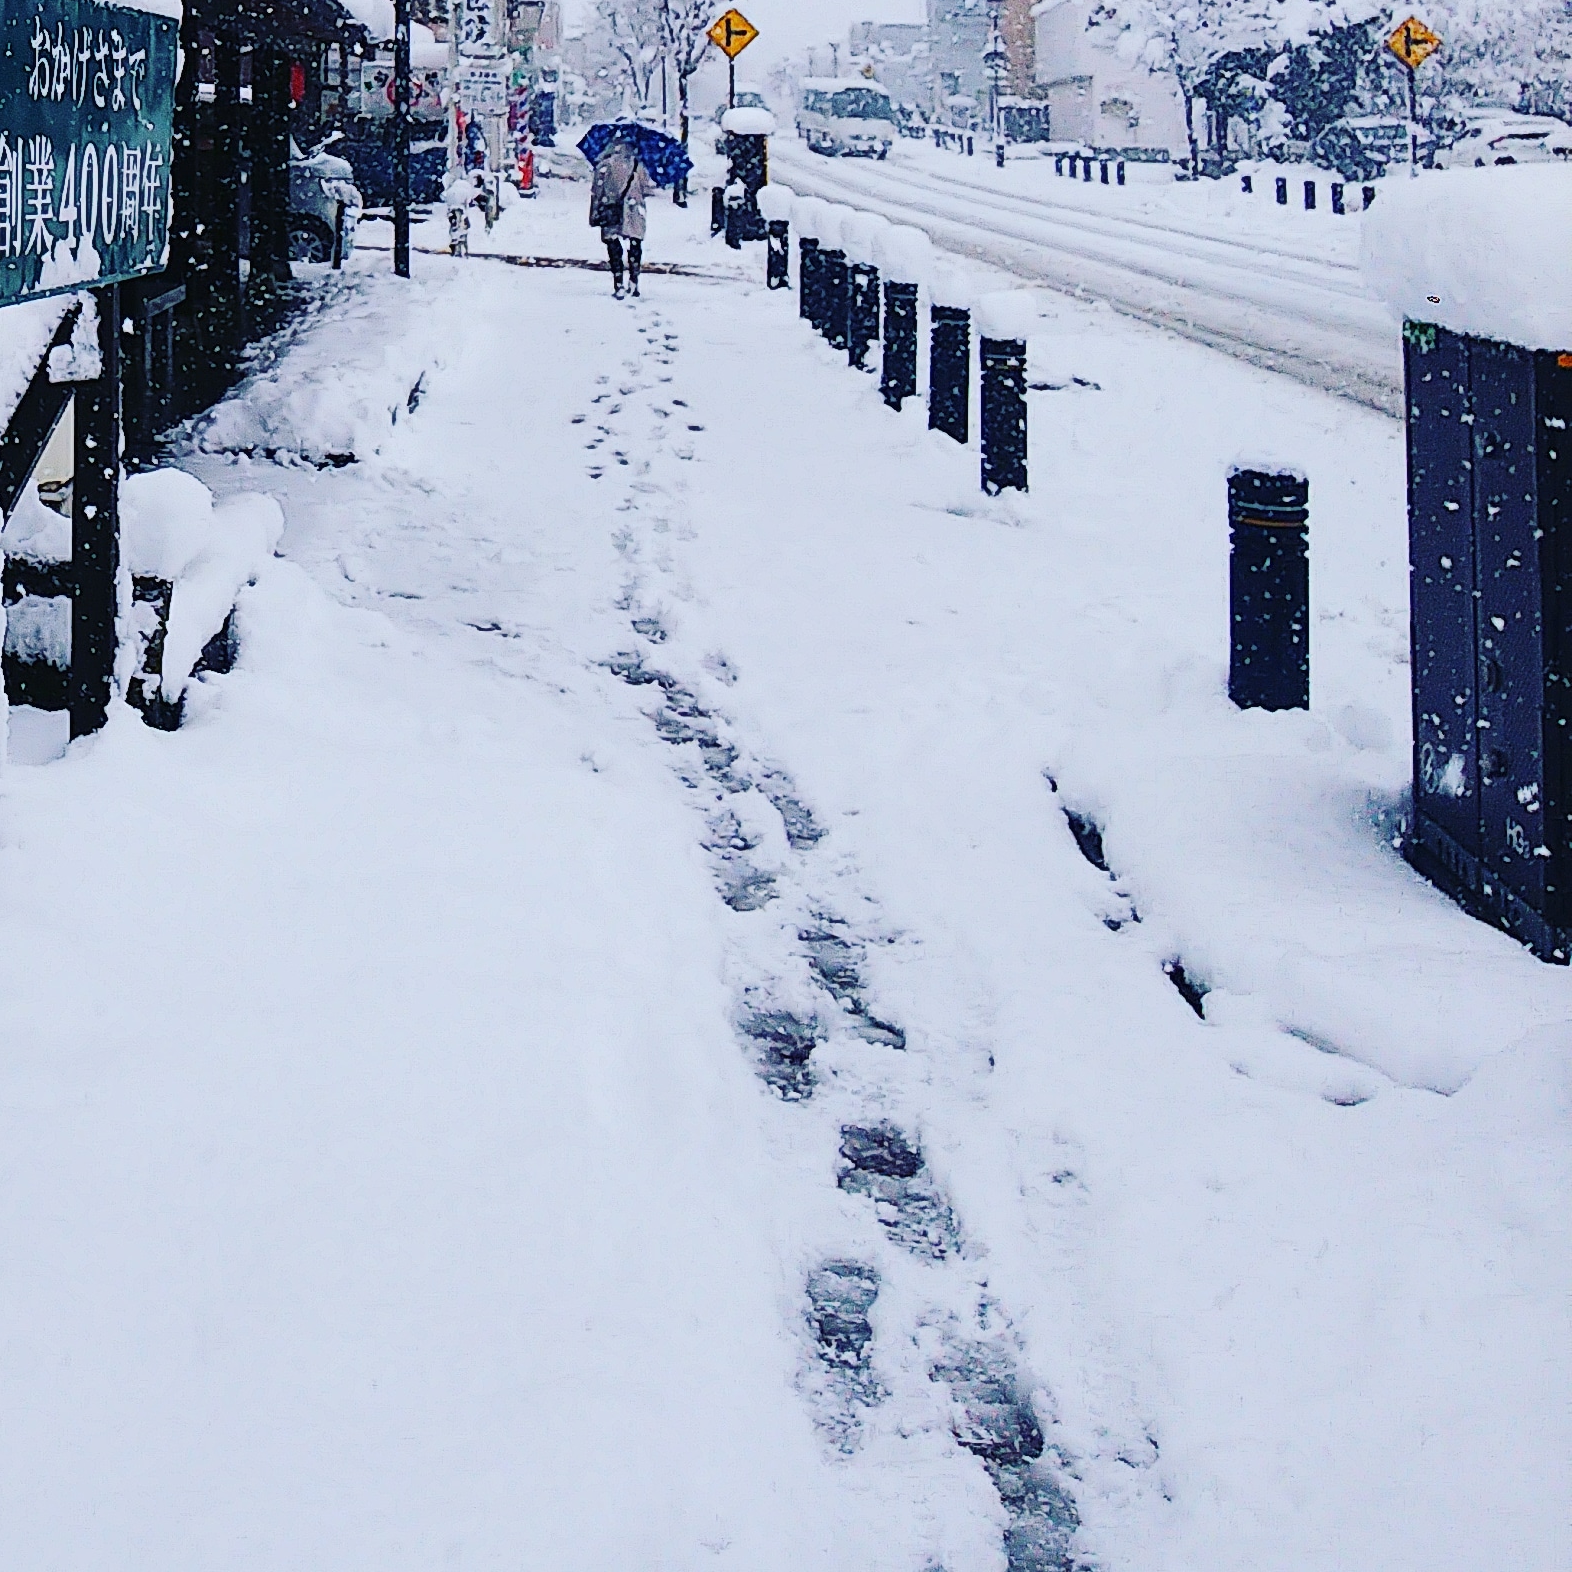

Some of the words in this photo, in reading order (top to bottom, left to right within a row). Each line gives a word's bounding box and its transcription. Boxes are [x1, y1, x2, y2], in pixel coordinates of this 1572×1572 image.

[29, 15, 146, 112] おかげさまで
